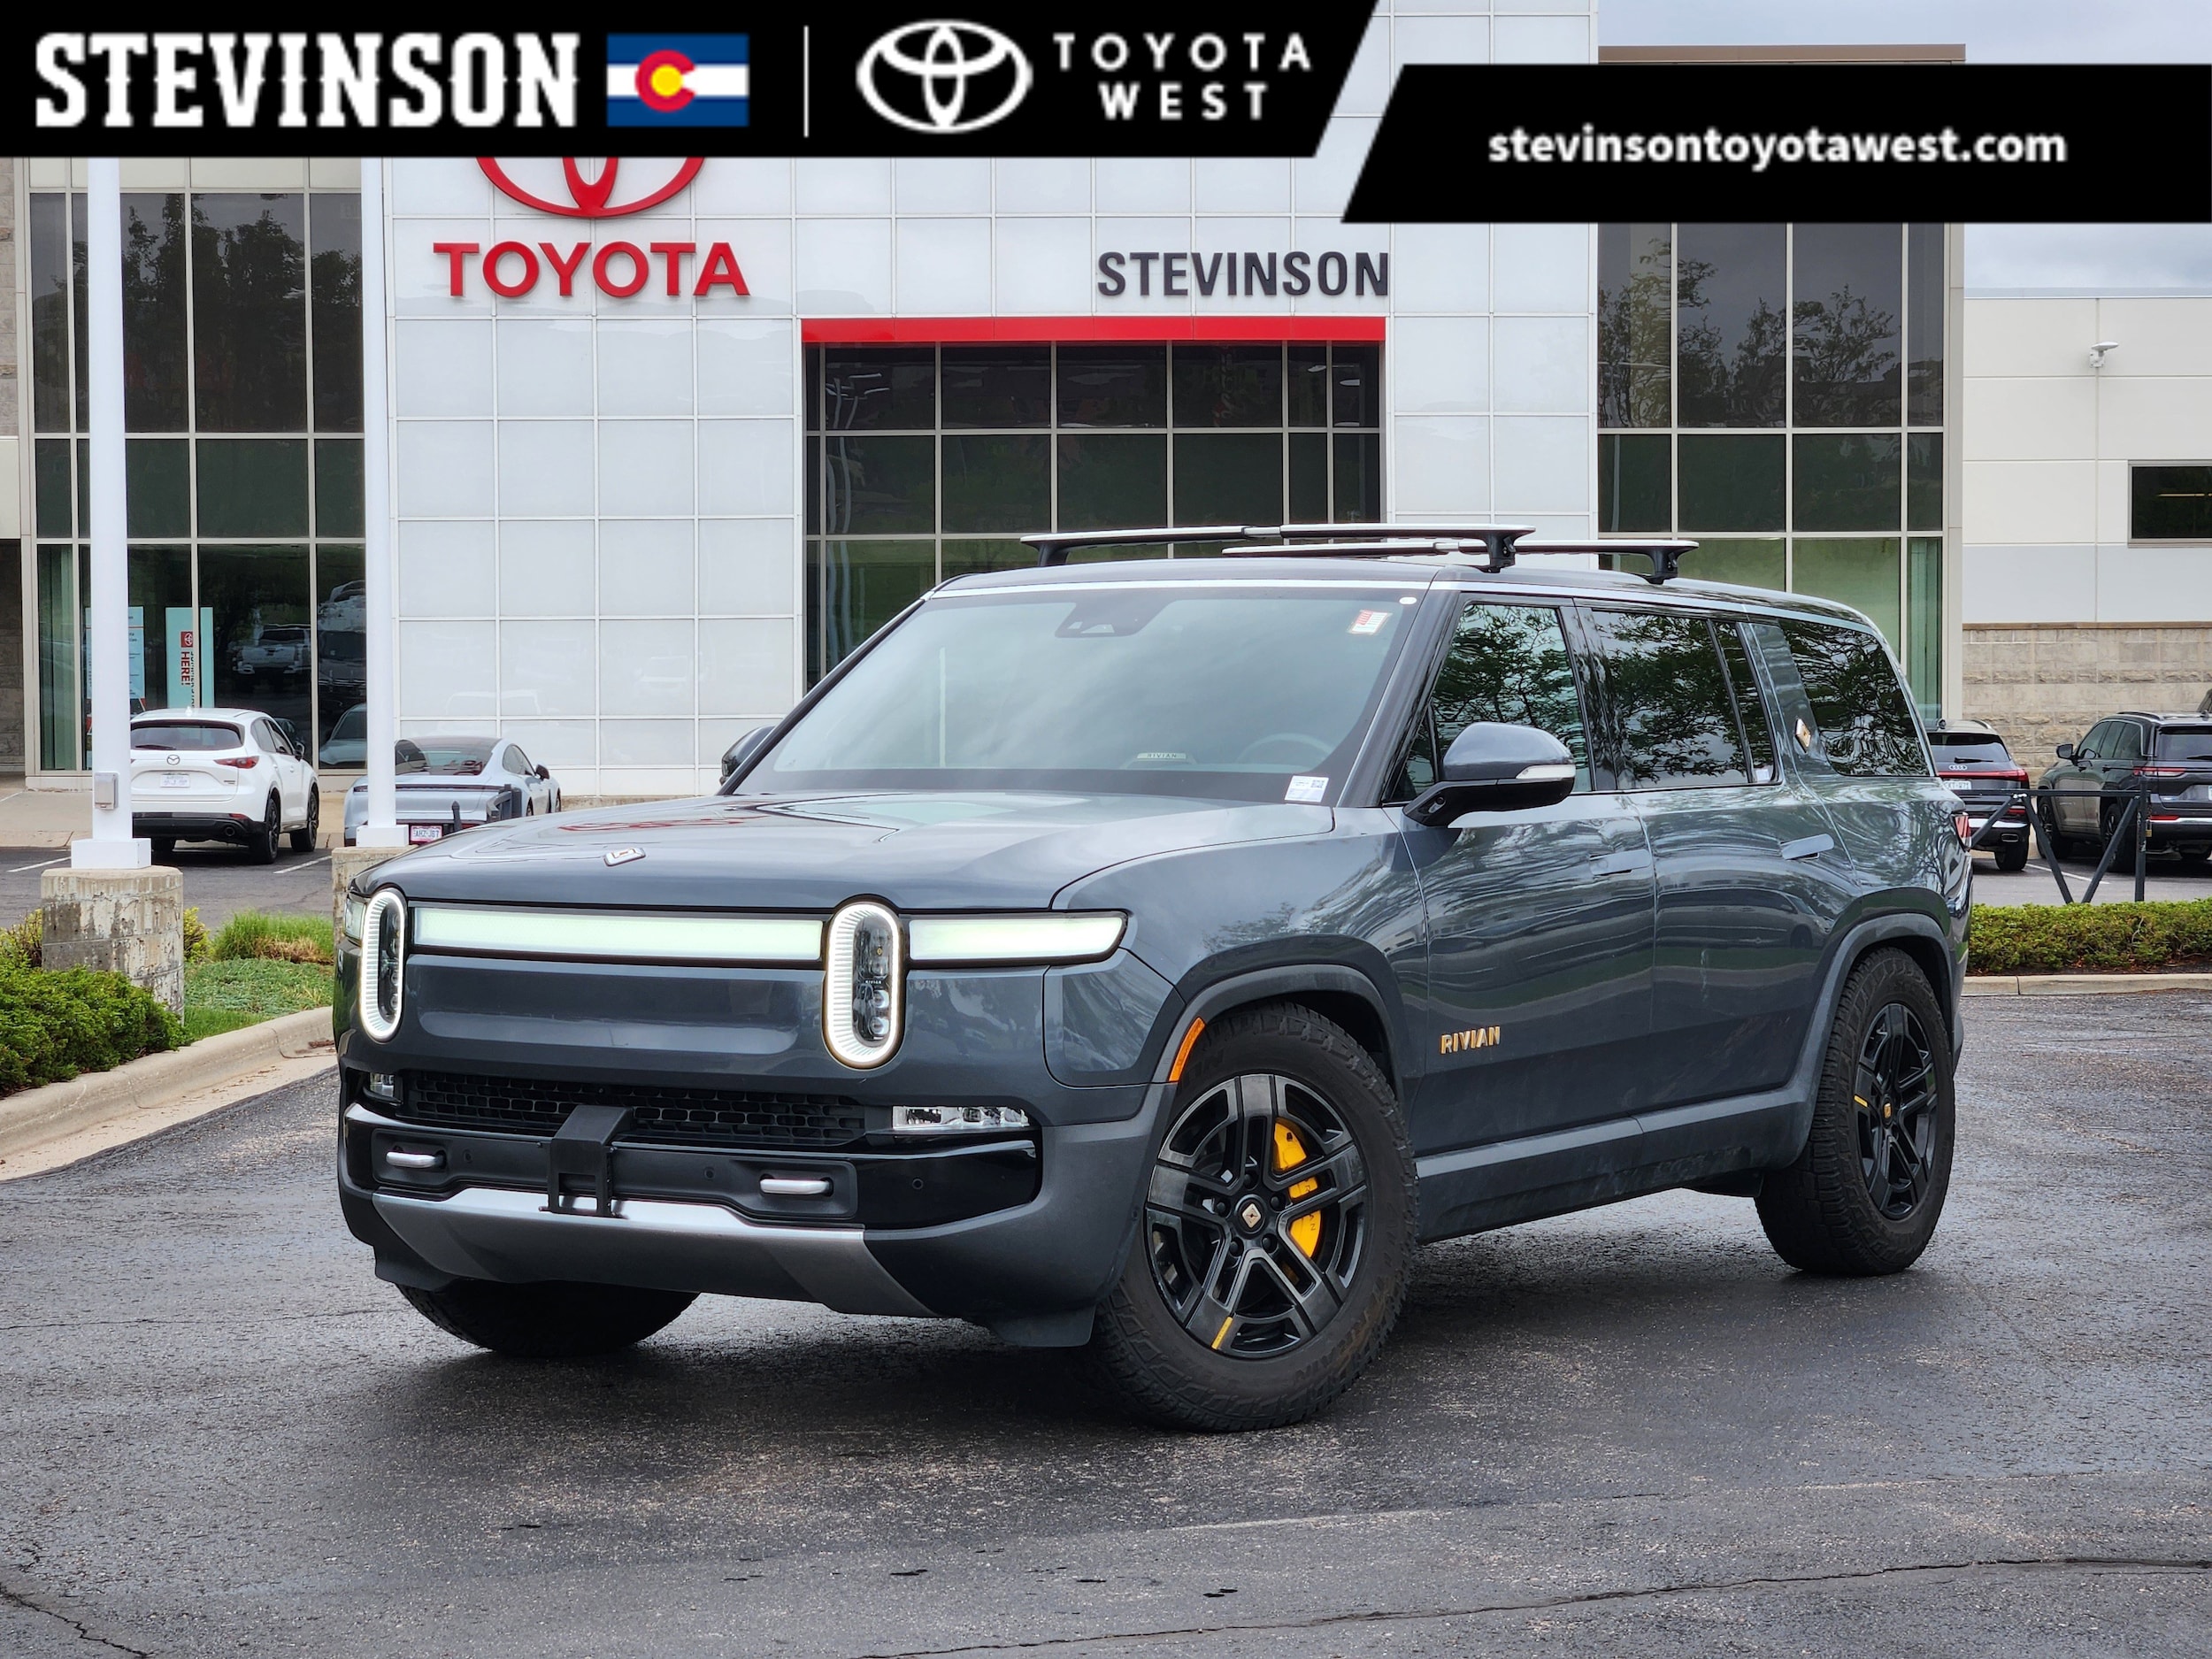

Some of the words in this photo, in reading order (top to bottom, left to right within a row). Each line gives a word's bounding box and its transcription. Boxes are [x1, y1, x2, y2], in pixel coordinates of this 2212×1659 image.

[433, 241, 749, 298] TOYOTA
[1097, 251, 1388, 296] STEVINSON
[180, 651, 191, 686] HERE!
[1440, 1025, 1501, 1055] RIVIAN
